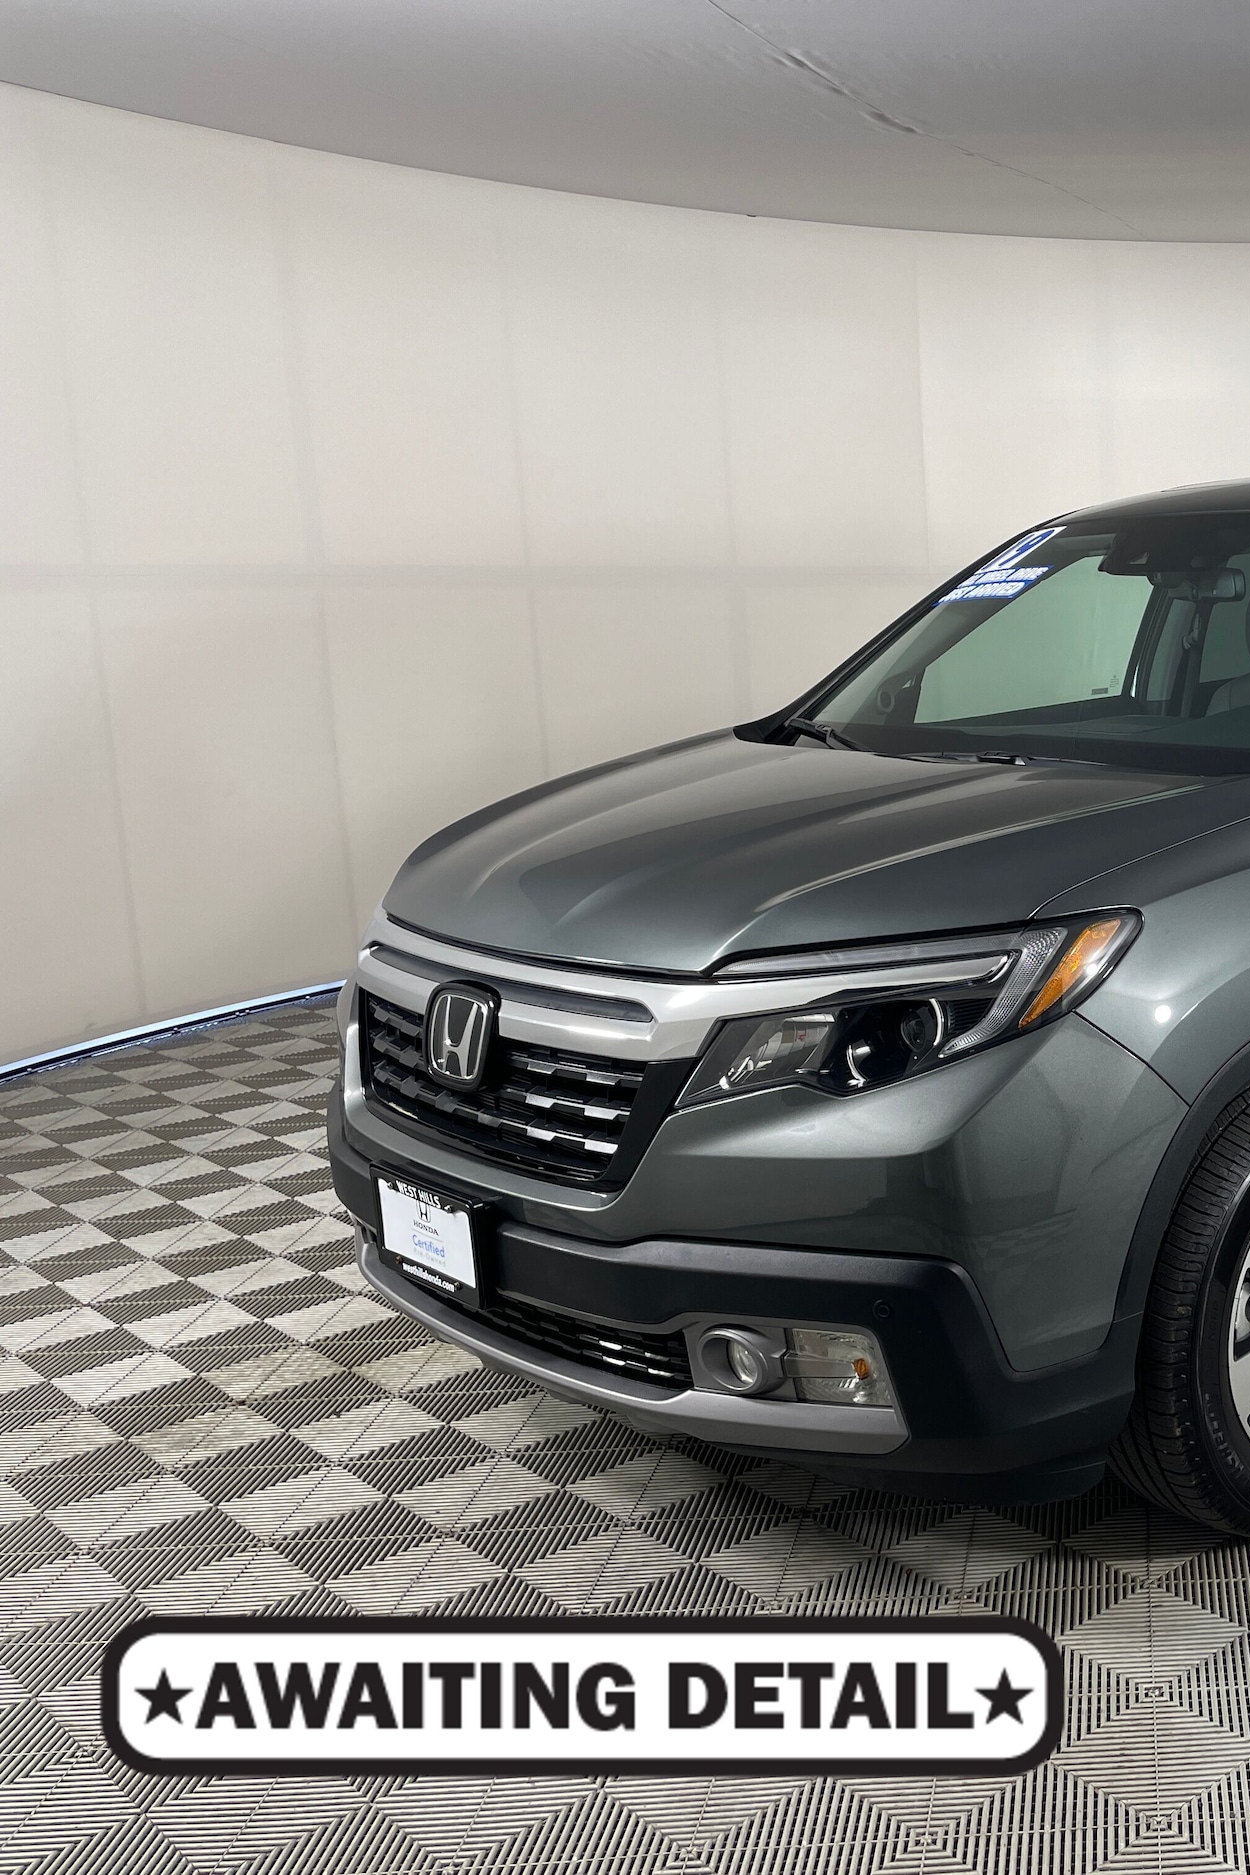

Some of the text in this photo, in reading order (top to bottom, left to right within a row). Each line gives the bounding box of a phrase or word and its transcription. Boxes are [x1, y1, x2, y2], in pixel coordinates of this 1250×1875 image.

[964, 582, 1025, 598] ARRIVED
[396, 1180, 441, 1209] WEST HILLS
[413, 1220, 440, 1236] HONDA
[412, 1234, 446, 1258] Certified
[402, 1262, 455, 1293] westhillshonda.com
